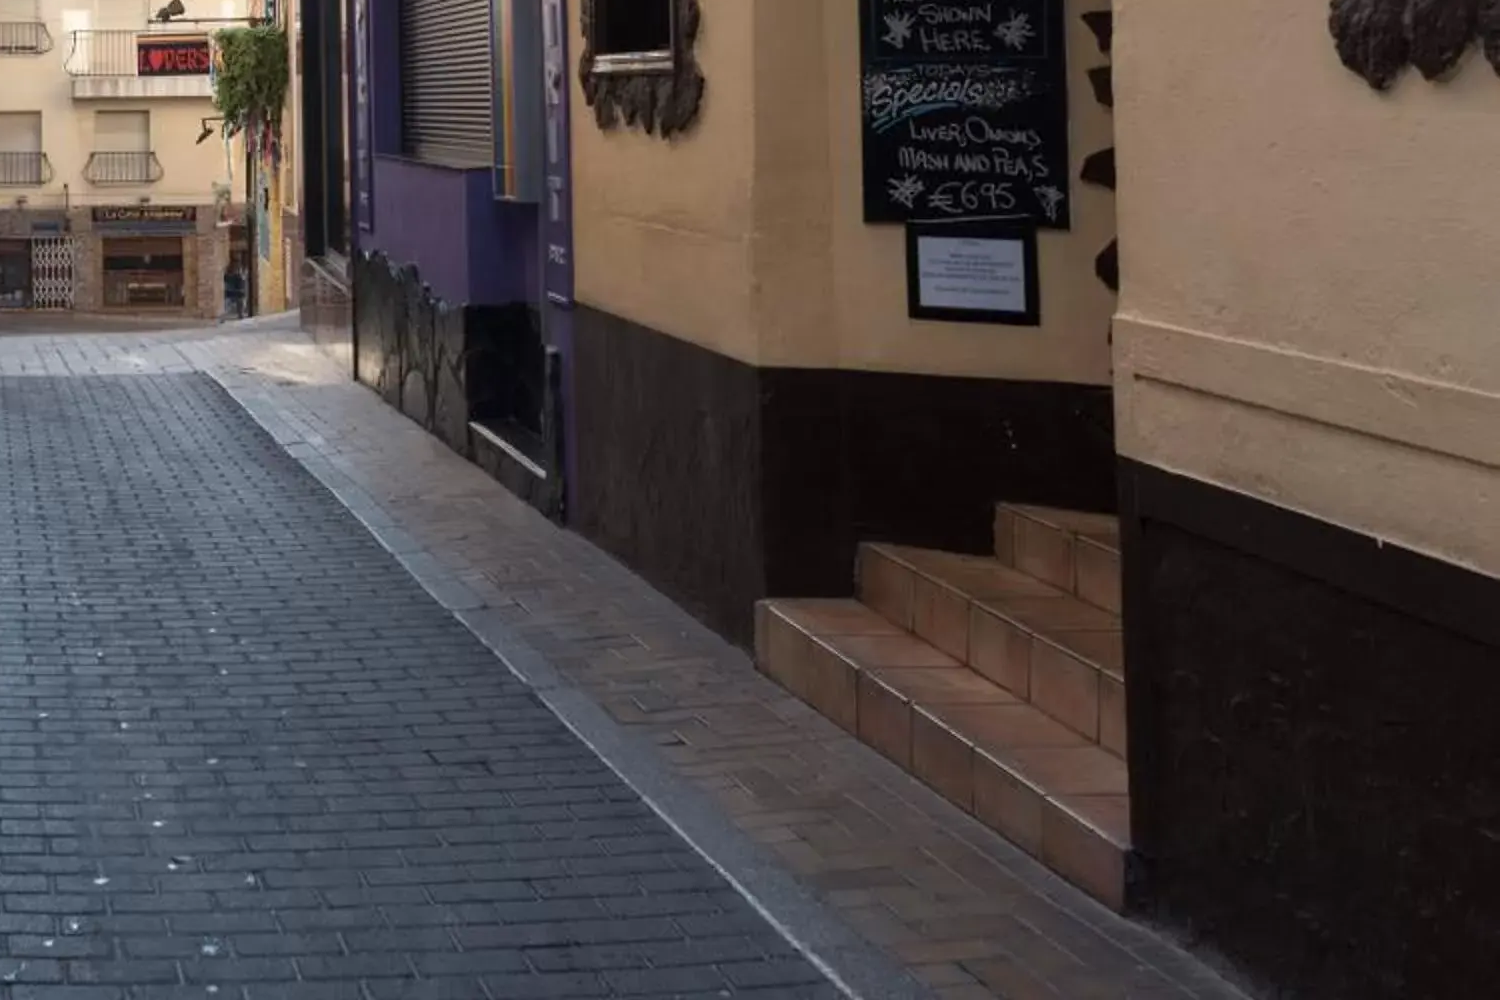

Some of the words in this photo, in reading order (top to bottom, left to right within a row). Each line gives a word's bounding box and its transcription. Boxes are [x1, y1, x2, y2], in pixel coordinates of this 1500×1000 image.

[917, 3, 992, 25] SHOWN
[919, 26, 991, 53] HERE
[915, 63, 991, 80] TODAYS
[871, 78, 982, 118] Specials
[899, 147, 949, 171] MASH
[954, 153, 989, 173] AND
